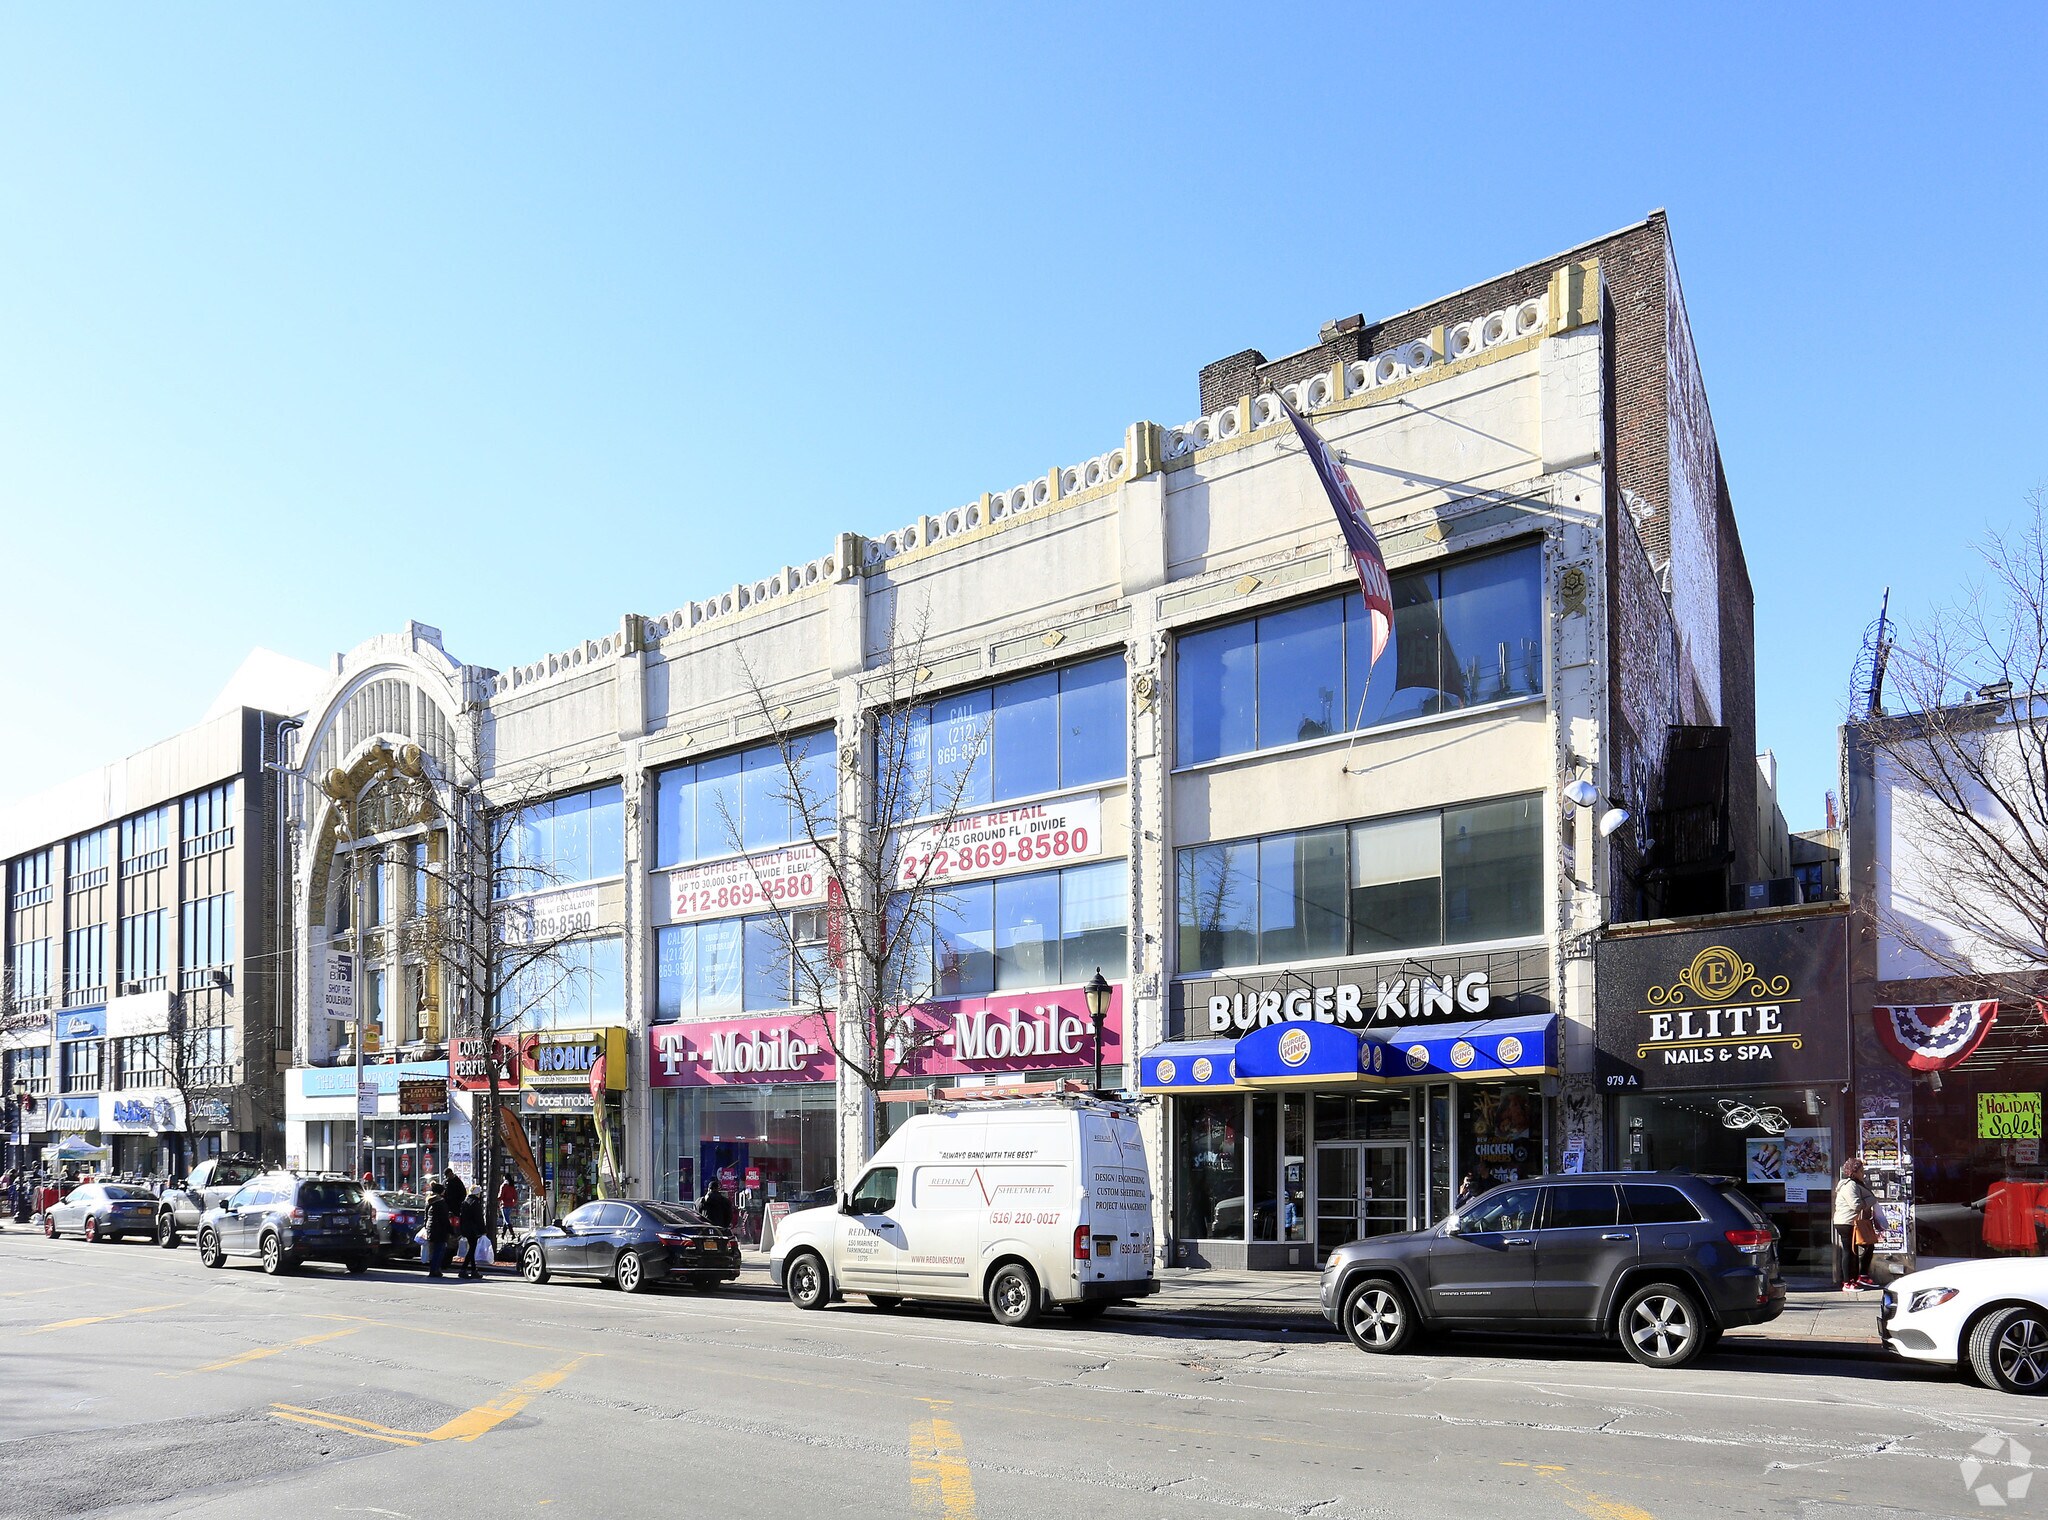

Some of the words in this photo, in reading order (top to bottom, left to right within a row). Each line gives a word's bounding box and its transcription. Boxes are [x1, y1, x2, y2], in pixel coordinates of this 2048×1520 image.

[950, 705, 975, 724] CALL
[948, 723, 976, 745] (212)
[932, 817, 982, 836] PRIME
[987, 805, 1047, 827] RETAIL
[921, 840, 932, 850] 75
[943, 836, 960, 848] 125
[963, 830, 1006, 844] GROUND
[1009, 826, 1021, 837] FL
[1030, 817, 1067, 832] DIVIDE
[903, 827, 1089, 880] 212-869-8580
[671, 867, 704, 882] PRIME
[703, 860, 738, 876] OFFICE
[745, 852, 782, 871] NEWLY
[786, 847, 818, 862] BUILT
[679, 883, 689, 893] UP
[690, 882, 700, 891] TO
[701, 876, 725, 889] 30,000
[727, 874, 738, 884] SQ
[739, 873, 748, 882] FT
[755, 867, 781, 879] DIVIDE
[787, 862, 810, 875] ELEV.
[572, 889, 593, 899] FLOOR
[676, 873, 814, 915] 212-869-8580
[556, 900, 595, 913] ESCALATOR
[667, 932, 685, 945] CALL
[328, 984, 341, 994] SHOP
[341, 985, 351, 995] THE
[1208, 983, 1363, 1032] BURGER
[1377, 972, 1491, 1020] KING
[1649, 1005, 1782, 1041] ELITE
[1283, 1034, 1306, 1049] BURGER
[1284, 1041, 1307, 1058] KING
[1455, 1050, 1472, 1061] KING
[1501, 1046, 1519, 1057] KING
[1664, 1048, 1715, 1065] NAILS
[1718, 1047, 1733, 1062] &
[1737, 1044, 1773, 1061] SPA
[454, 1060, 499, 1077] PERFUE
[1160, 1067, 1174, 1076] KING
[1196, 1066, 1210, 1075] KING
[316, 1074, 335, 1090] THE
[1606, 1074, 1625, 1087] 979
[1627, 1074, 1638, 1086] A
[538, 1094, 564, 1106] boost
[565, 1092, 595, 1106] mobile
[1986, 1098, 2036, 1114] HOLIDAY
[50, 1100, 96, 1131] Rainbow
[1989, 1113, 2038, 1136] Sale!
[939, 1151, 967, 1160] "ALWAYS
[967, 1151, 985, 1159] BANG
[985, 1151, 1002, 1159] WITH
[1003, 1151, 1016, 1159] THE
[1016, 1150, 1039, 1159] BEST"
[1475, 1143, 1514, 1155] CHICKEN
[1095, 1173, 1115, 1182] DESIGN
[1118, 1175, 1145, 1184] ENGINEERING
[1097, 1188, 1119, 1196] CUSTOM
[1095, 1201, 1118, 1211] PROJECT
[1119, 1202, 1147, 1211] MANAGEMENT
[989, 1211, 1013, 1225] (516)
[1015, 1212, 1060, 1225] 210-0017
[848, 1228, 882, 1237] REDLINE
